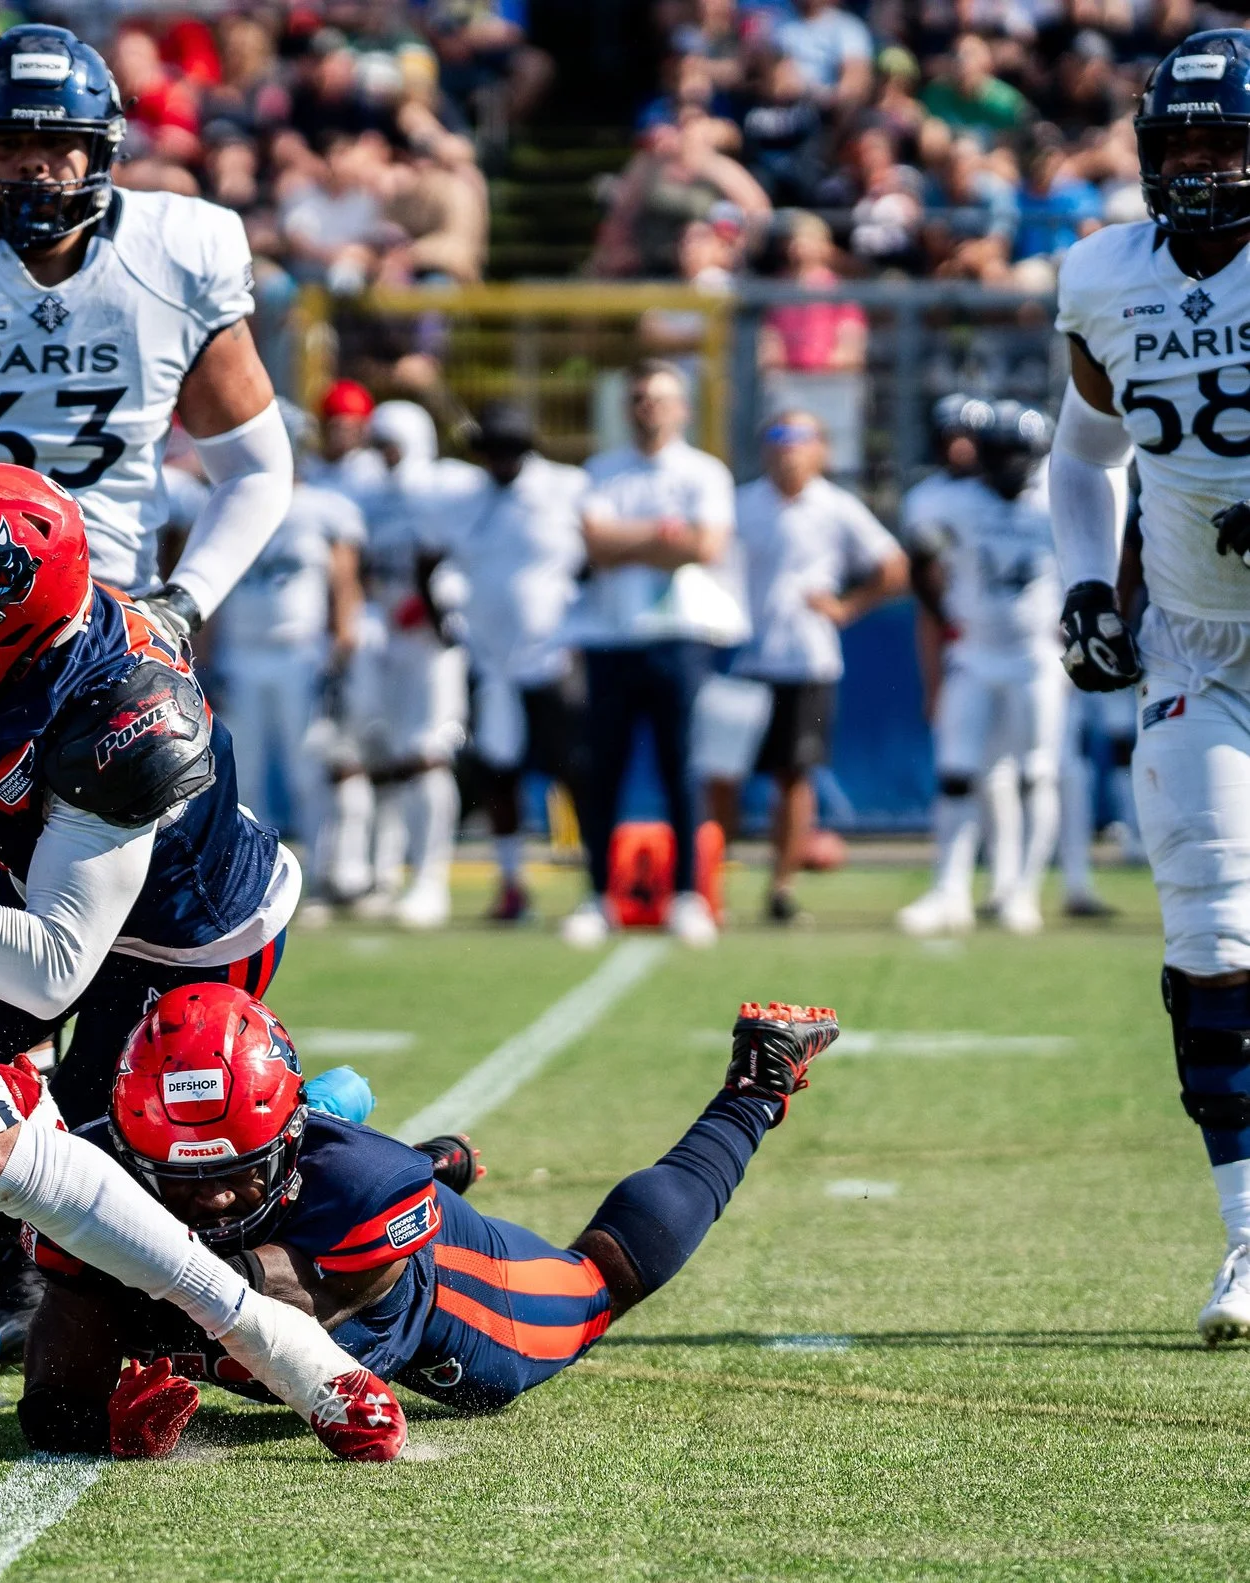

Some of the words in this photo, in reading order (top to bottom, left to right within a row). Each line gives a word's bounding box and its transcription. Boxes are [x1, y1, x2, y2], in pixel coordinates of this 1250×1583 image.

[1121, 363, 1250, 457] 58
[2, 782, 20, 798] LEAGUE
[6, 777, 31, 802] FOOTBALL
[168, 1080, 217, 1092] DEFSHOP
[178, 1147, 224, 1157] FORELLE
[390, 1213, 416, 1232] EUROPEAN
[392, 1225, 413, 1238] LEAGUE
[394, 1226, 420, 1244] FOOTBALL
